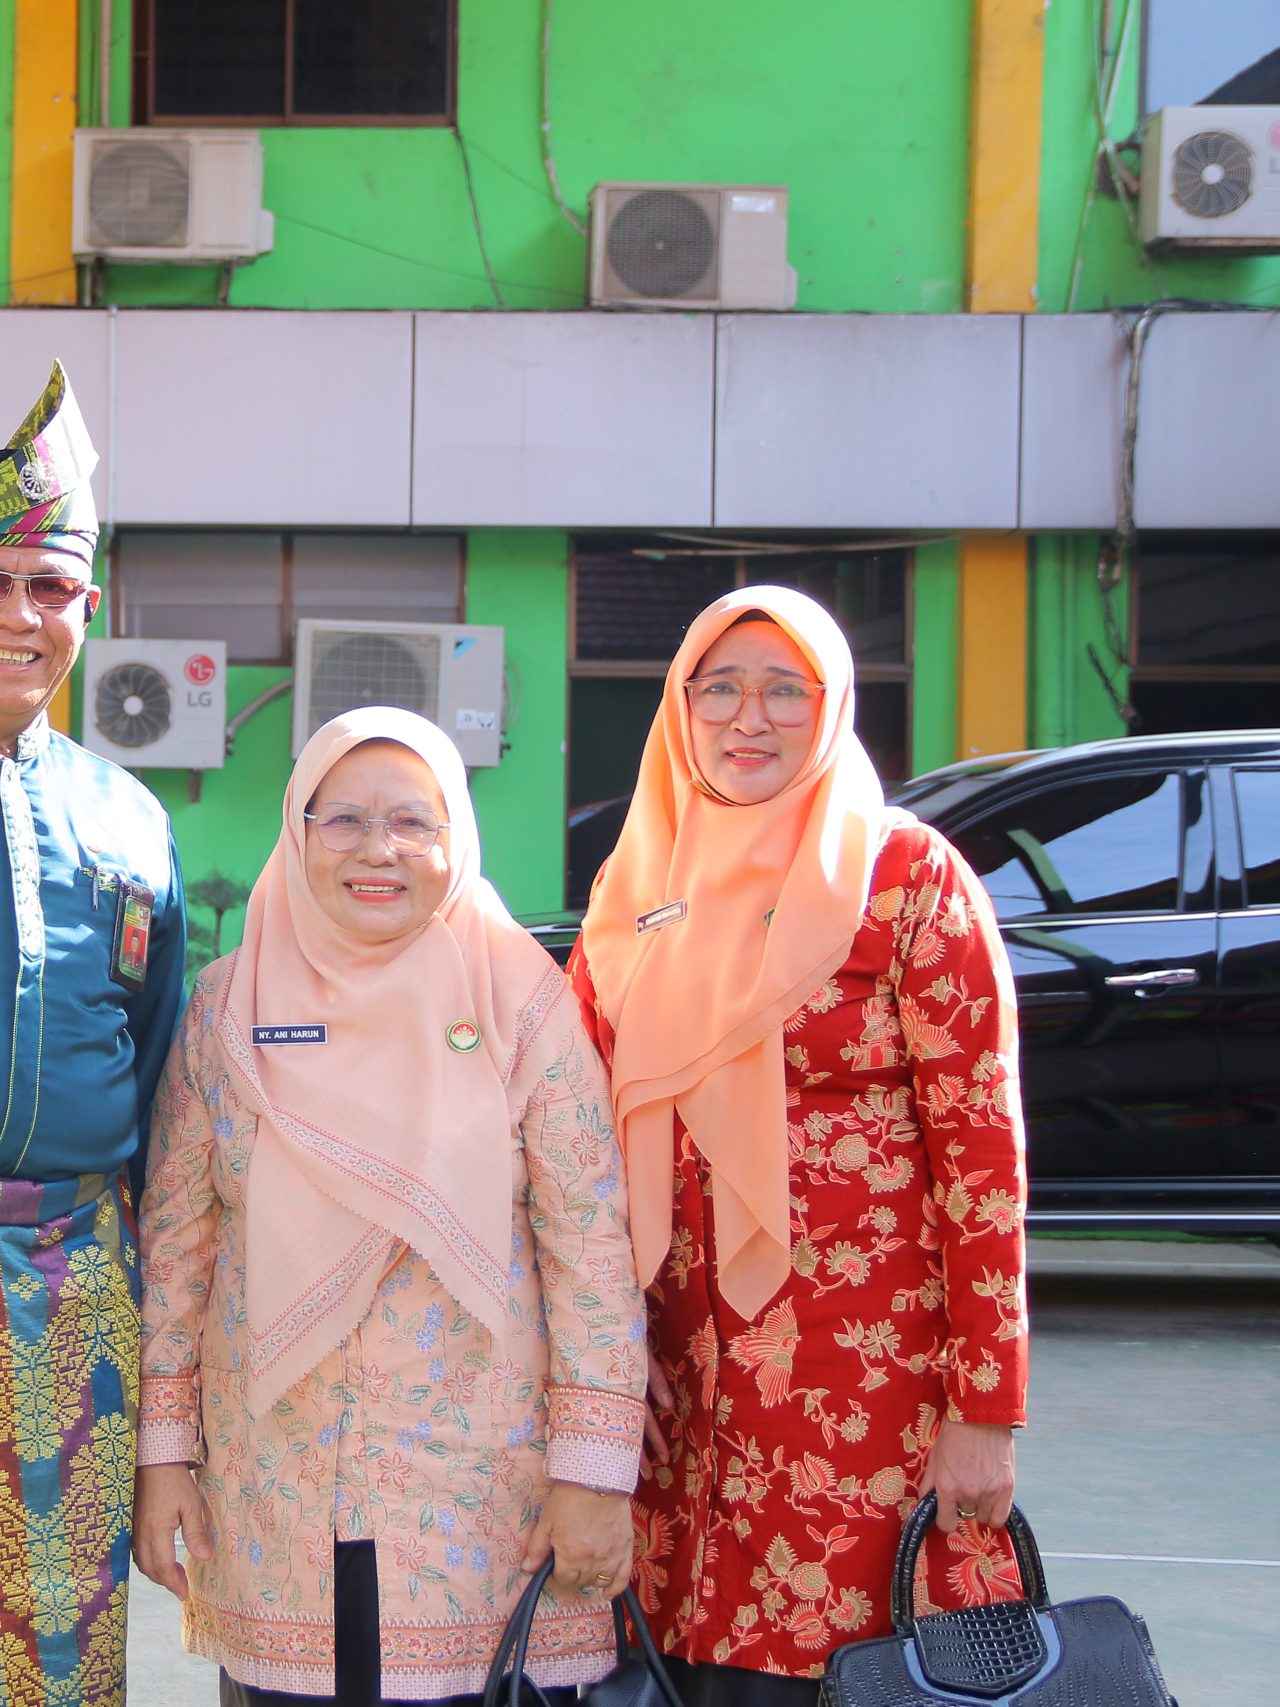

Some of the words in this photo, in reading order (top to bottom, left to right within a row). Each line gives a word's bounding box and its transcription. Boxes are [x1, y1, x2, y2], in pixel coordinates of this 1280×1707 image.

[187, 691, 212, 707] LG
[258, 1030, 272, 1040] NY.
[273, 1030, 288, 1039] ANI
[290, 1029, 320, 1039] HARUN
